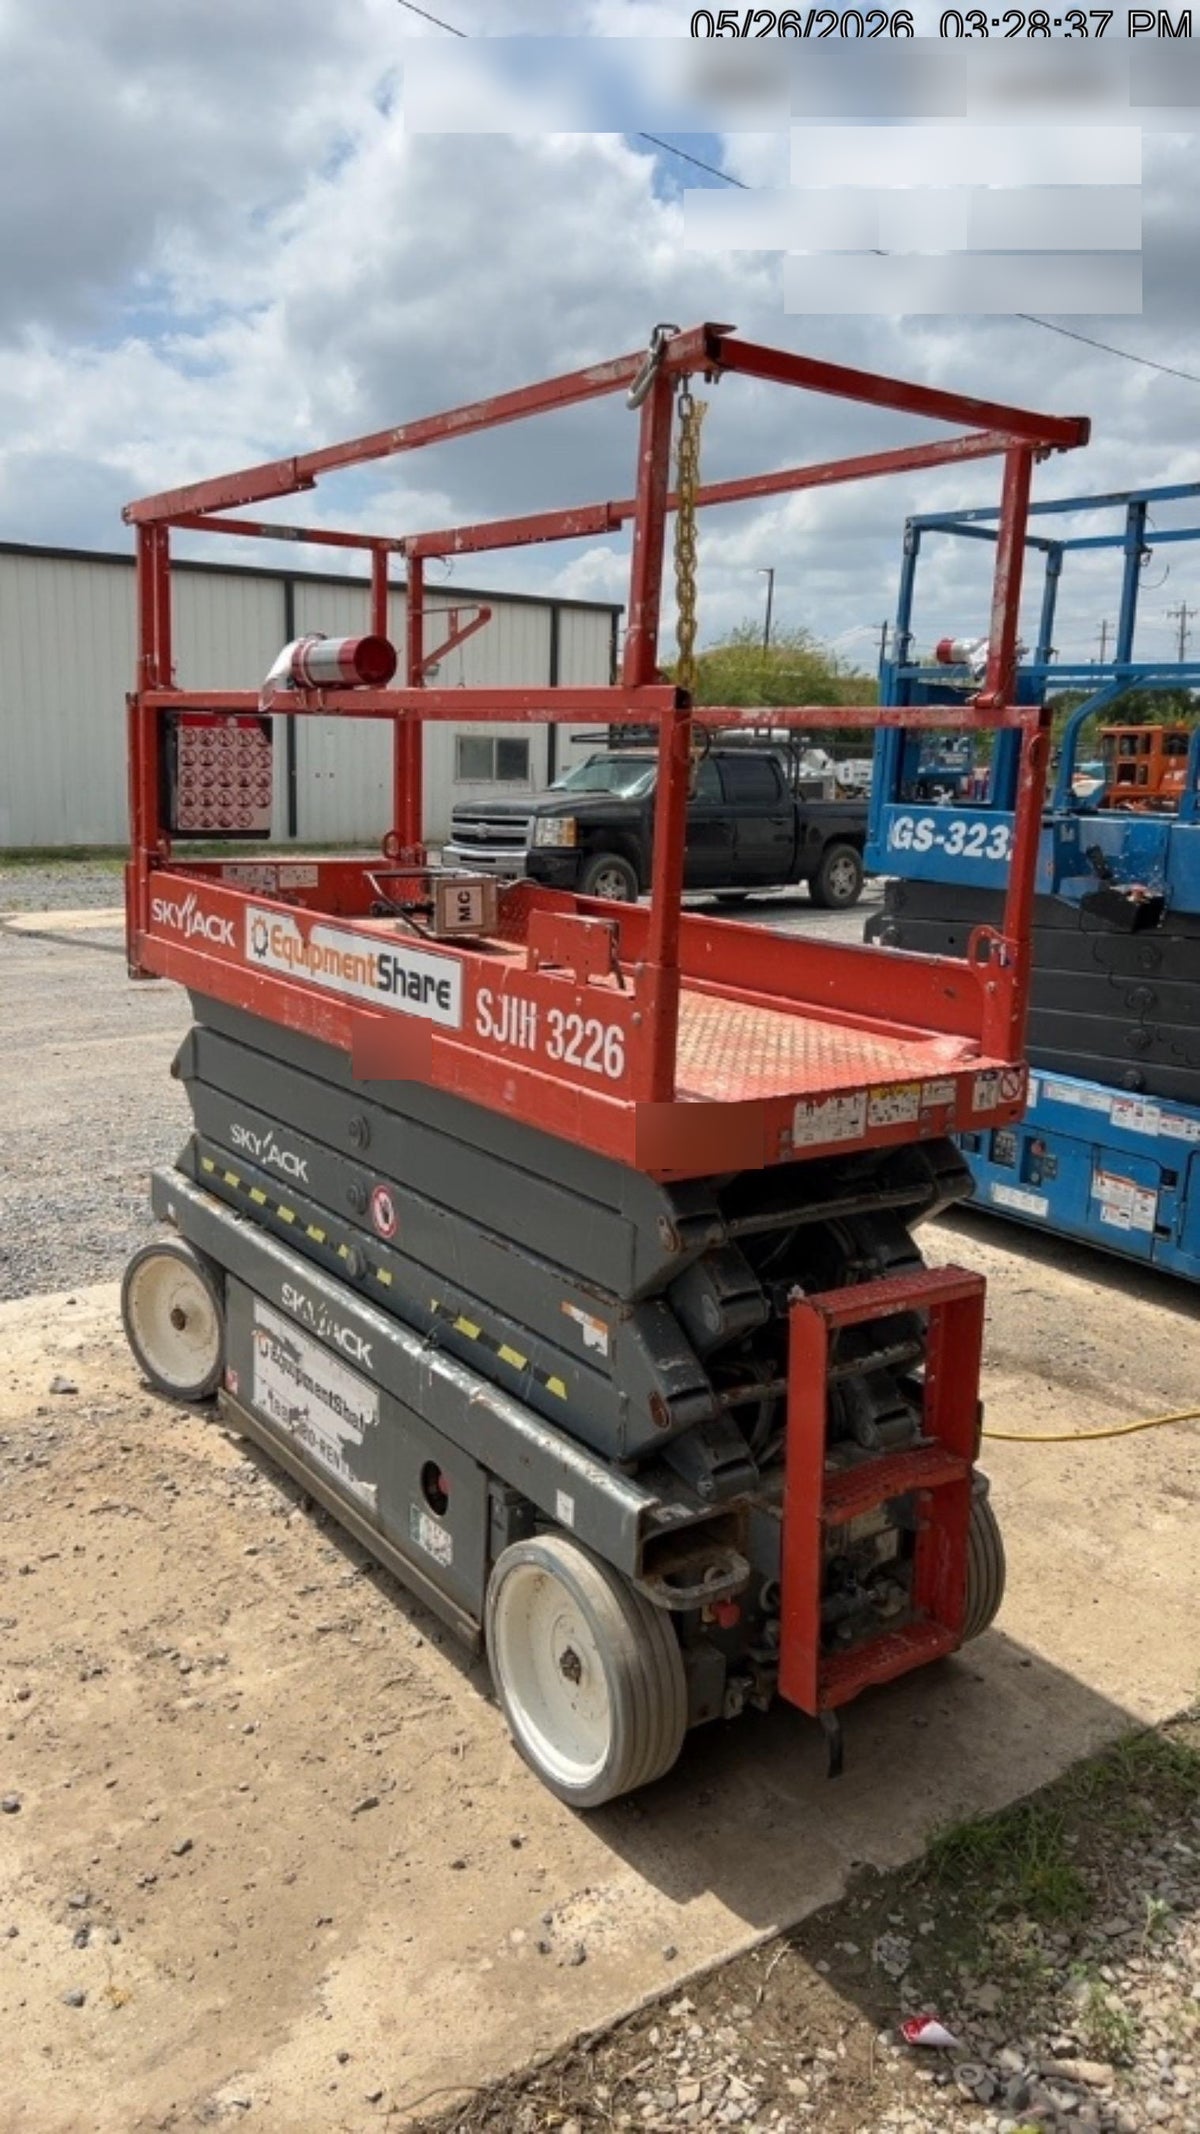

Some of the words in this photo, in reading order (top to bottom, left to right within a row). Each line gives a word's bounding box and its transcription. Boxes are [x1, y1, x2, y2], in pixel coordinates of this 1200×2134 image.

[891, 815, 1014, 861] GS-323
[151, 893, 236, 947] SKYJACK
[456, 890, 473, 922] MC
[270, 923, 452, 1011] EquipmentShare
[545, 1008, 625, 1079] 3226
